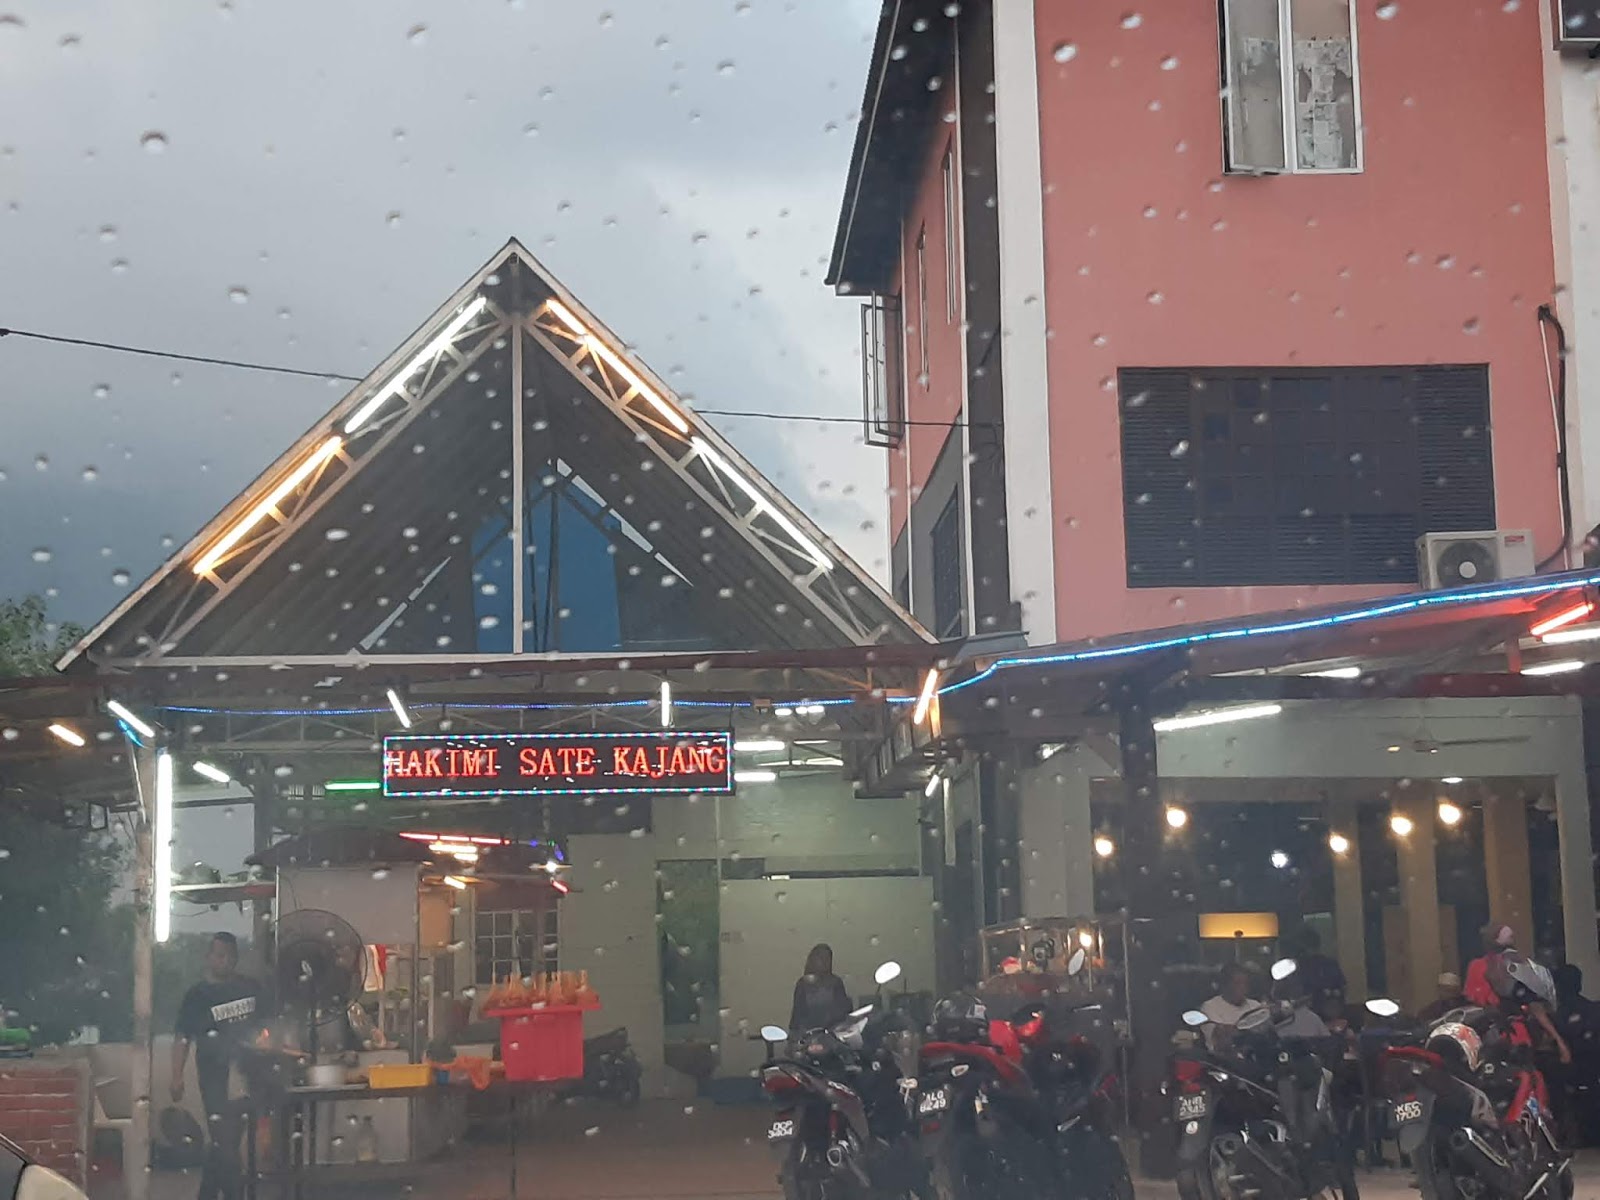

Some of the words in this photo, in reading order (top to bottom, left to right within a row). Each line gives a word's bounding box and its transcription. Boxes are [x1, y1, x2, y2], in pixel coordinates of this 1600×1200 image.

[386, 748, 498, 777] HAKIMI
[519, 747, 596, 776] SATE
[613, 746, 726, 779] KAJANG
